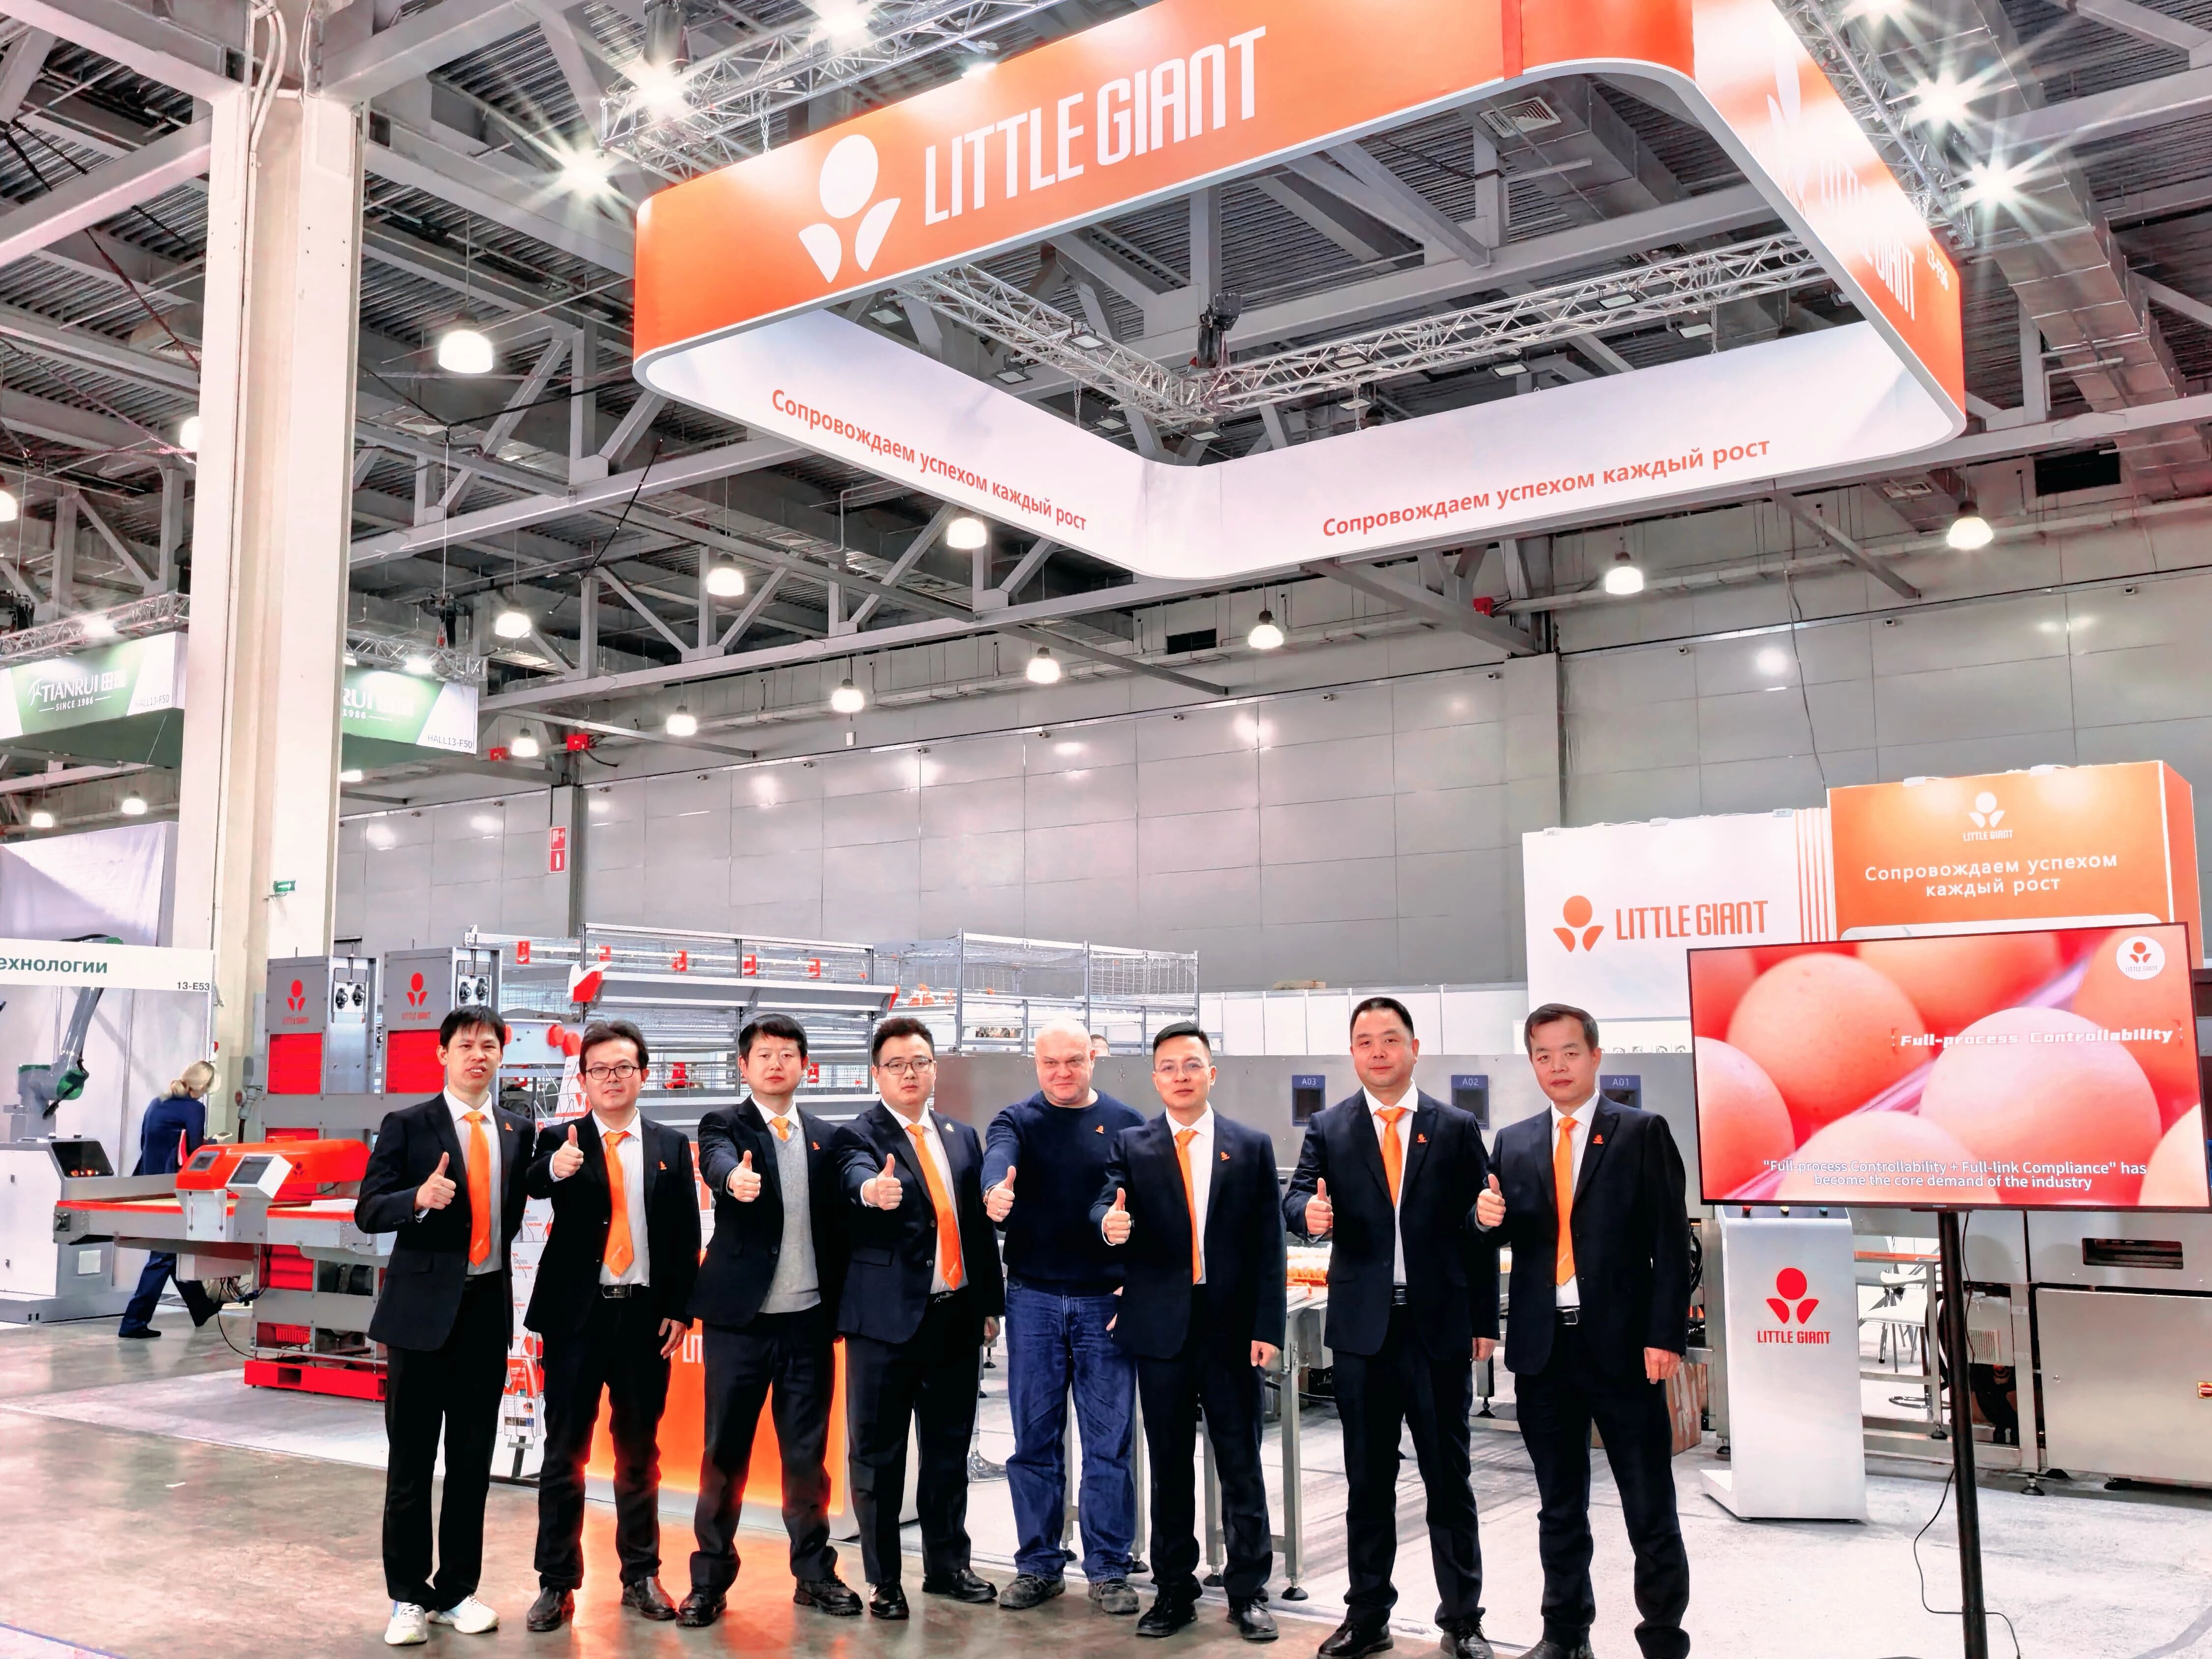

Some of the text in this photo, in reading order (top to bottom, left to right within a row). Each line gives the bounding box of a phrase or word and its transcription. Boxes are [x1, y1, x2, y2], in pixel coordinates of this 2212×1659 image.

[926, 26, 1266, 226] LITTLE GIANT
[772, 390, 1086, 531] Сопровождаем успехом каждый рост
[1323, 441, 1770, 536] Сопровождаем успехом каждый рост
[41, 674, 98, 703] TIANRUI
[55, 700, 75, 711] SINCE
[342, 709, 366, 720] 1986
[427, 734, 473, 749] HALL13-F50
[1963, 829, 2013, 842] LITTLE GIANT
[1865, 855, 2118, 882] Сопровождаем успехом
[1926, 878, 2061, 897] каждый рост
[1616, 900, 1769, 940] LITTLE GIANT
[177, 981, 210, 991] 13-E53
[1900, 1028, 2173, 1048] Full-process Controllability
[1302, 1077, 1316, 1086] A03
[1462, 1077, 1479, 1086] A02
[1612, 1078, 1629, 1086] A01
[1850, 1160, 1947, 1175] Controllability
[1962, 1161, 2019, 1173] Full-link
[2121, 1162, 2148, 1174] has
[1814, 1174, 2092, 1191] become the core demand of the industry
[1757, 1330, 1831, 1344] LITTLE GIANT
